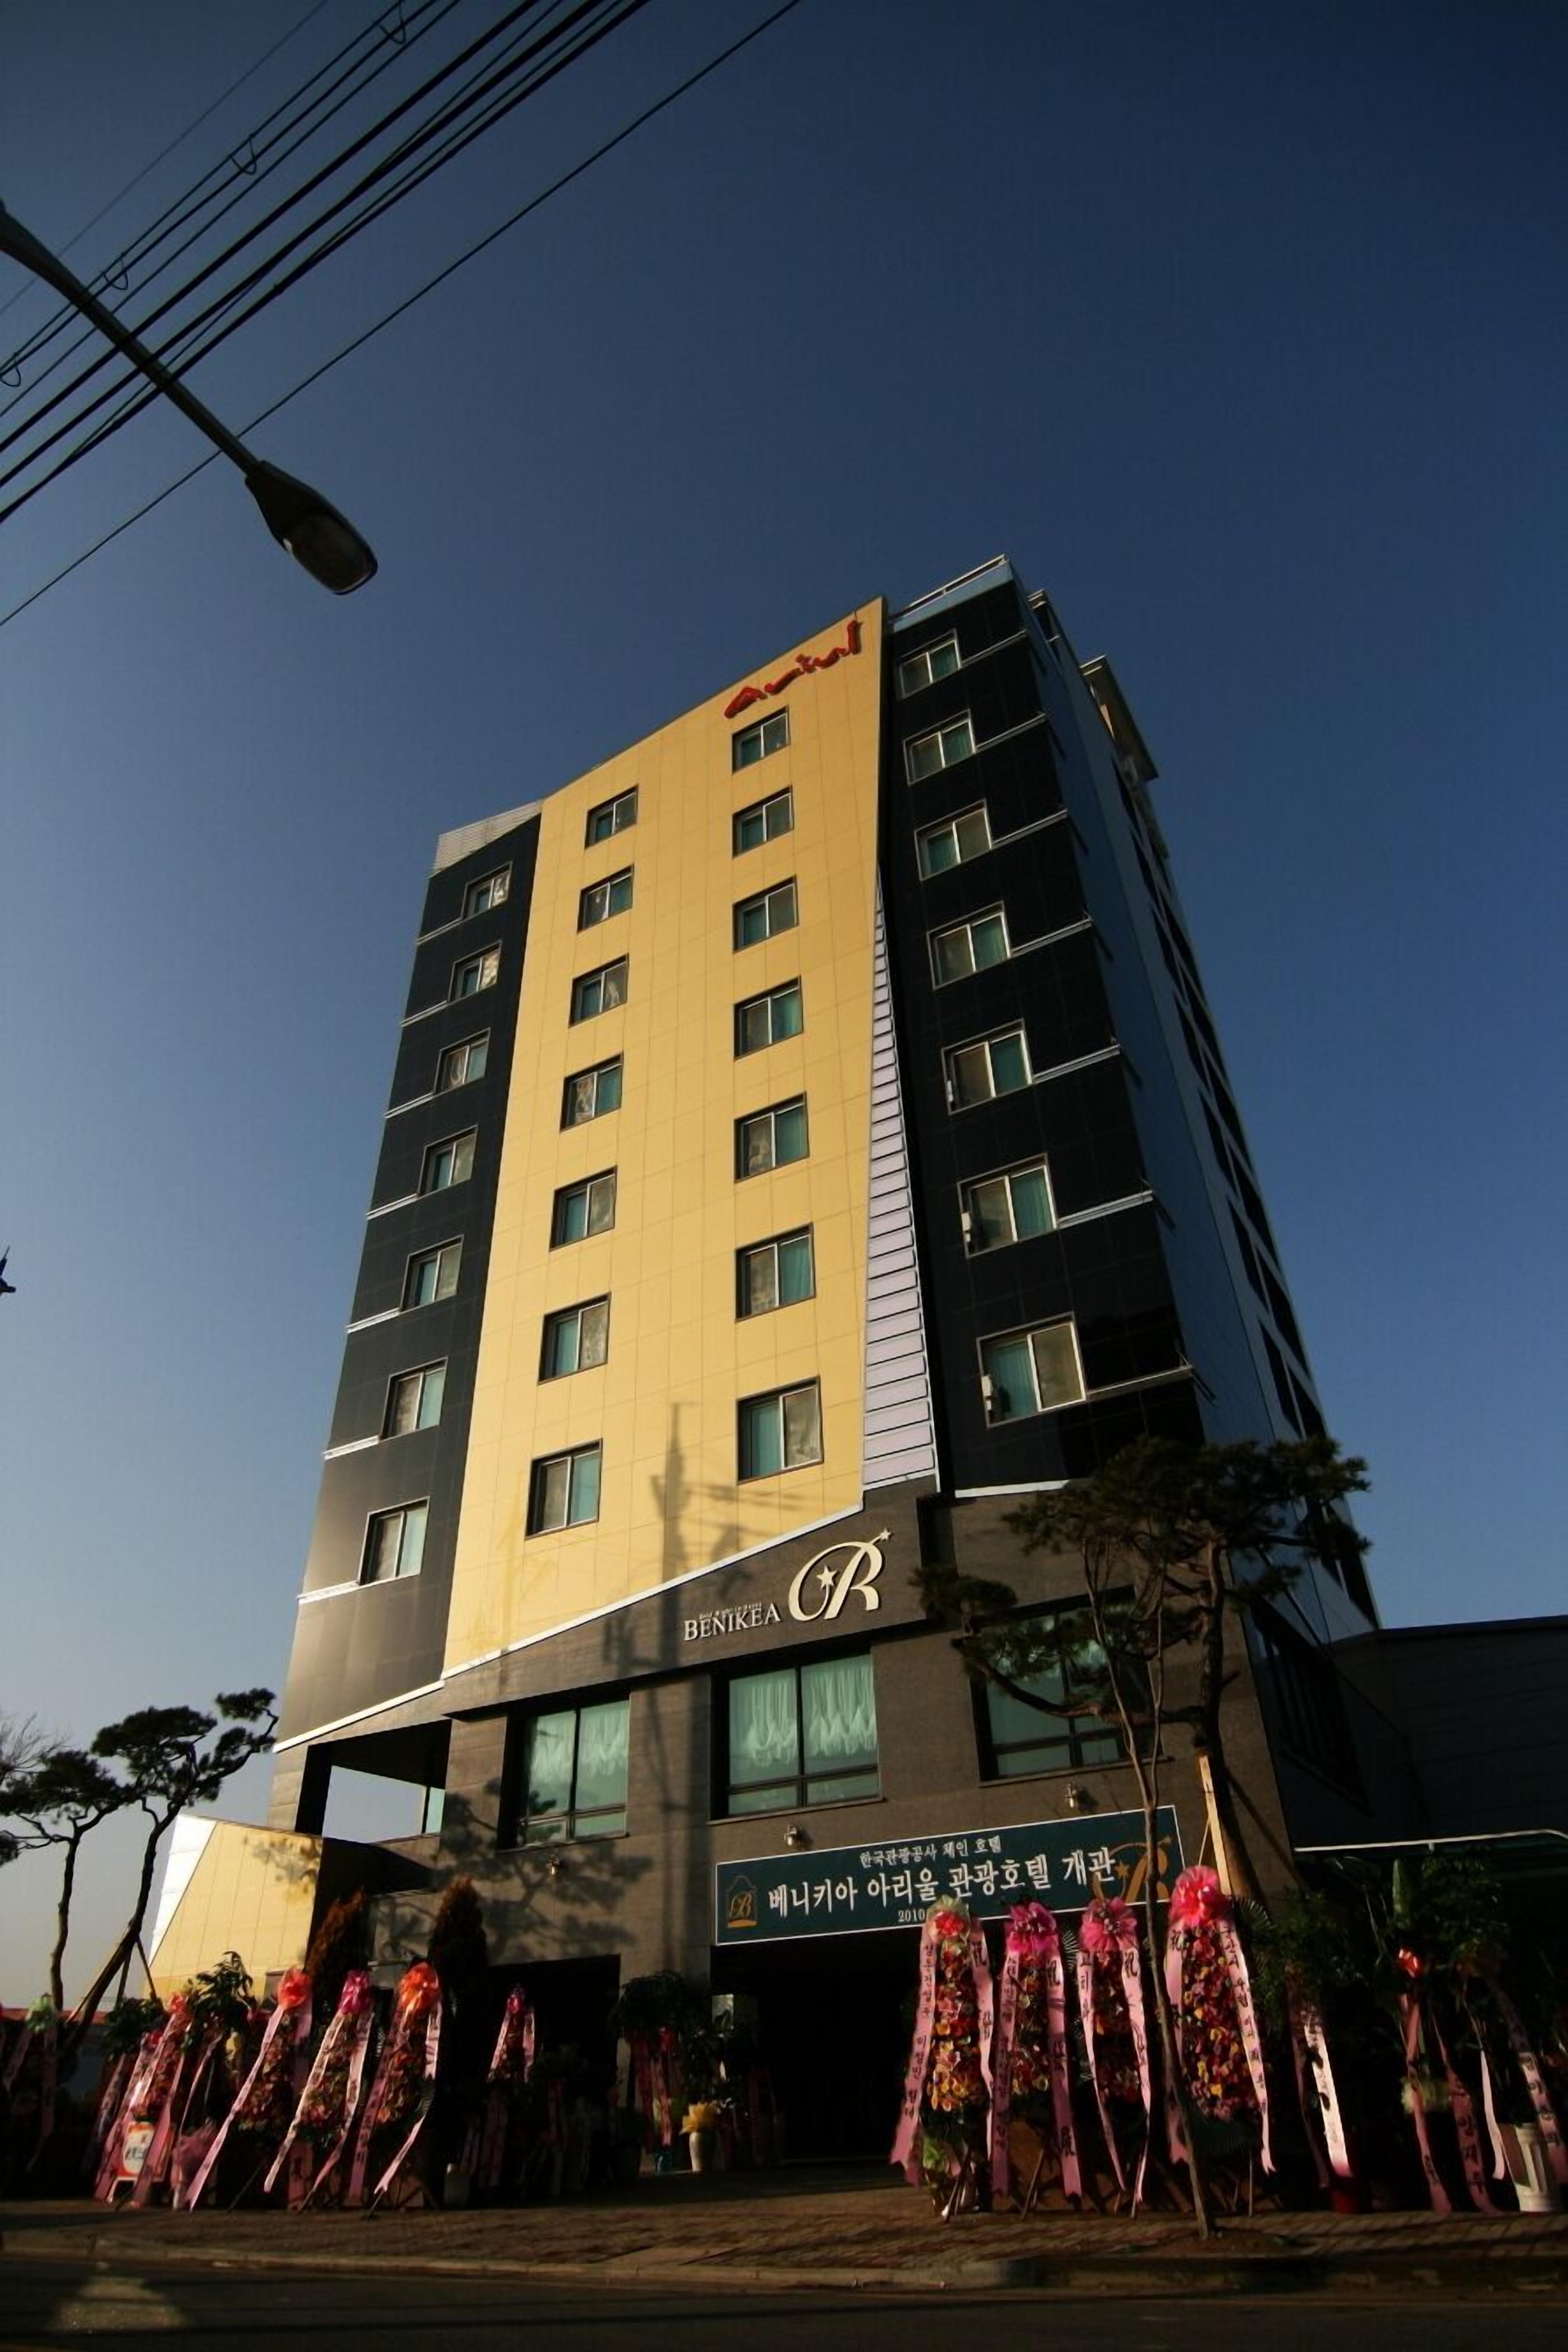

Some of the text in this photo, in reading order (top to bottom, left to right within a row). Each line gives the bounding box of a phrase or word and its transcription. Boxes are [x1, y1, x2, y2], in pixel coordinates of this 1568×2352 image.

[684, 1602, 781, 1641] BENIKEA
[973, 1835, 1002, 1854] 호텔
[768, 1847, 1116, 1918] 베니키아 아리울 관광호텔 개관
